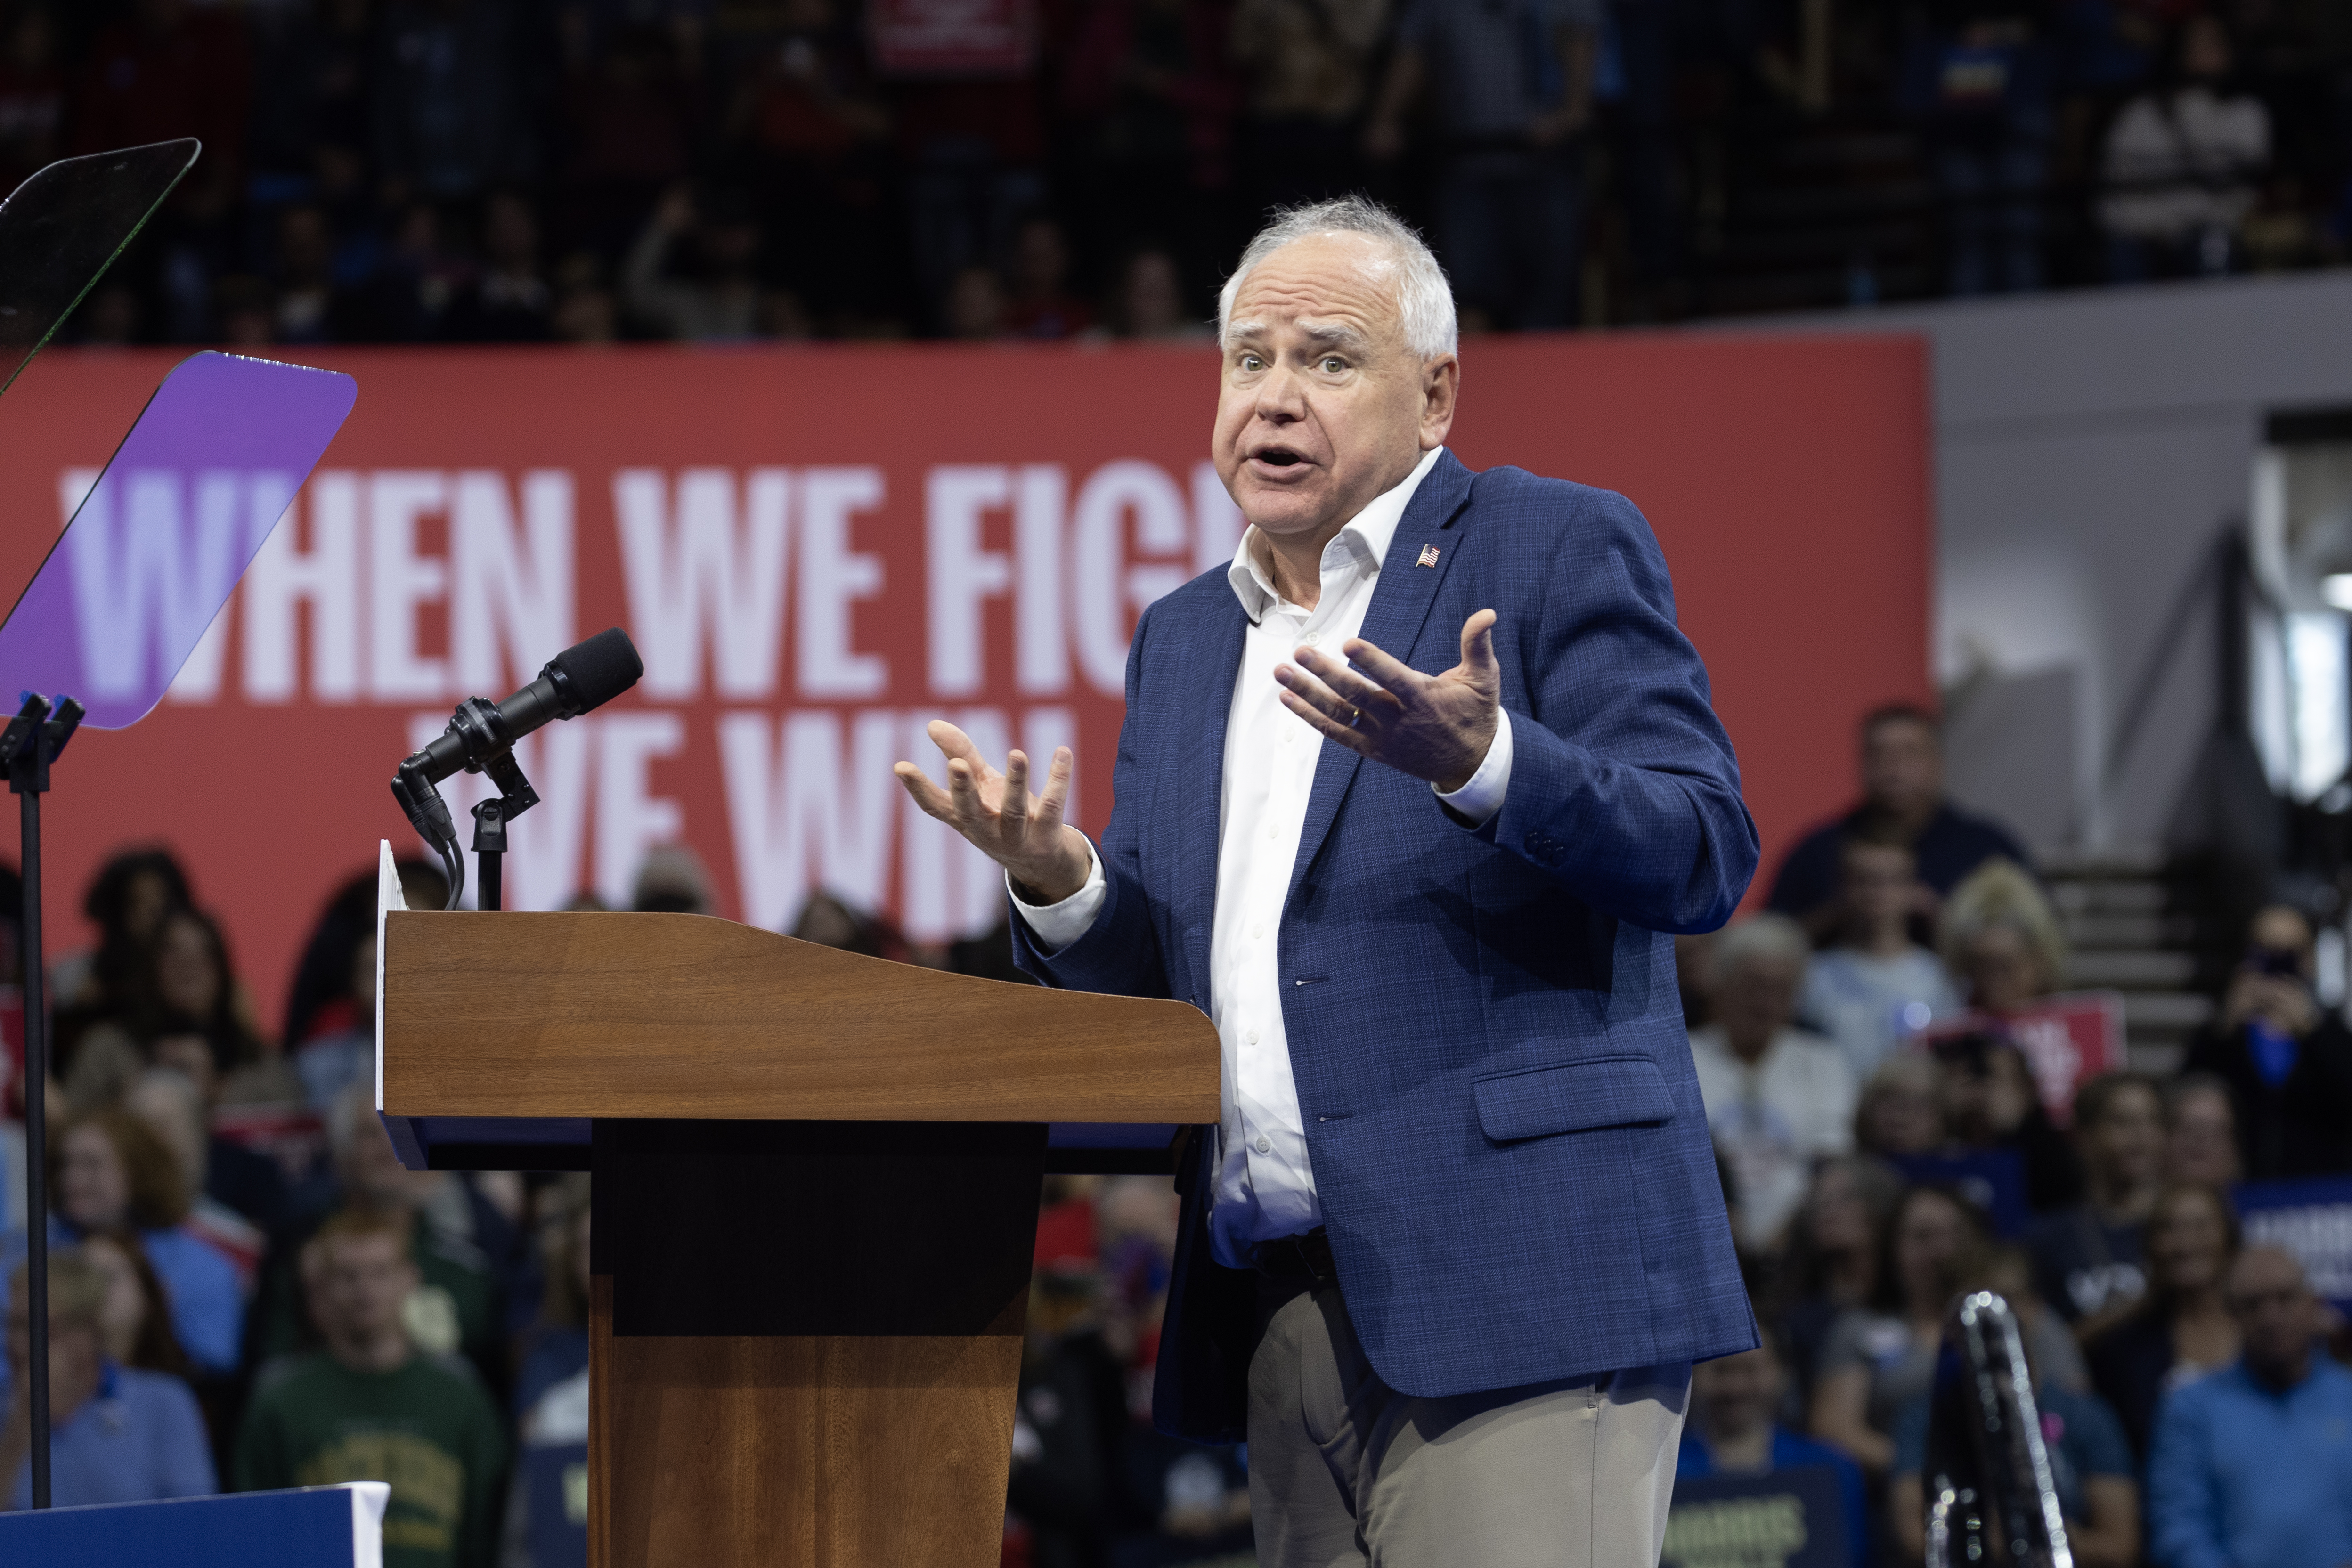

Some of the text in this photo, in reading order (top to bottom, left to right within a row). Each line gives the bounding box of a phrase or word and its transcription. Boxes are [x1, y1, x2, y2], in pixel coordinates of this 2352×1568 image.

[58, 467, 575, 703] WHEN
[614, 466, 887, 700] WE
[408, 711, 684, 913] WE
